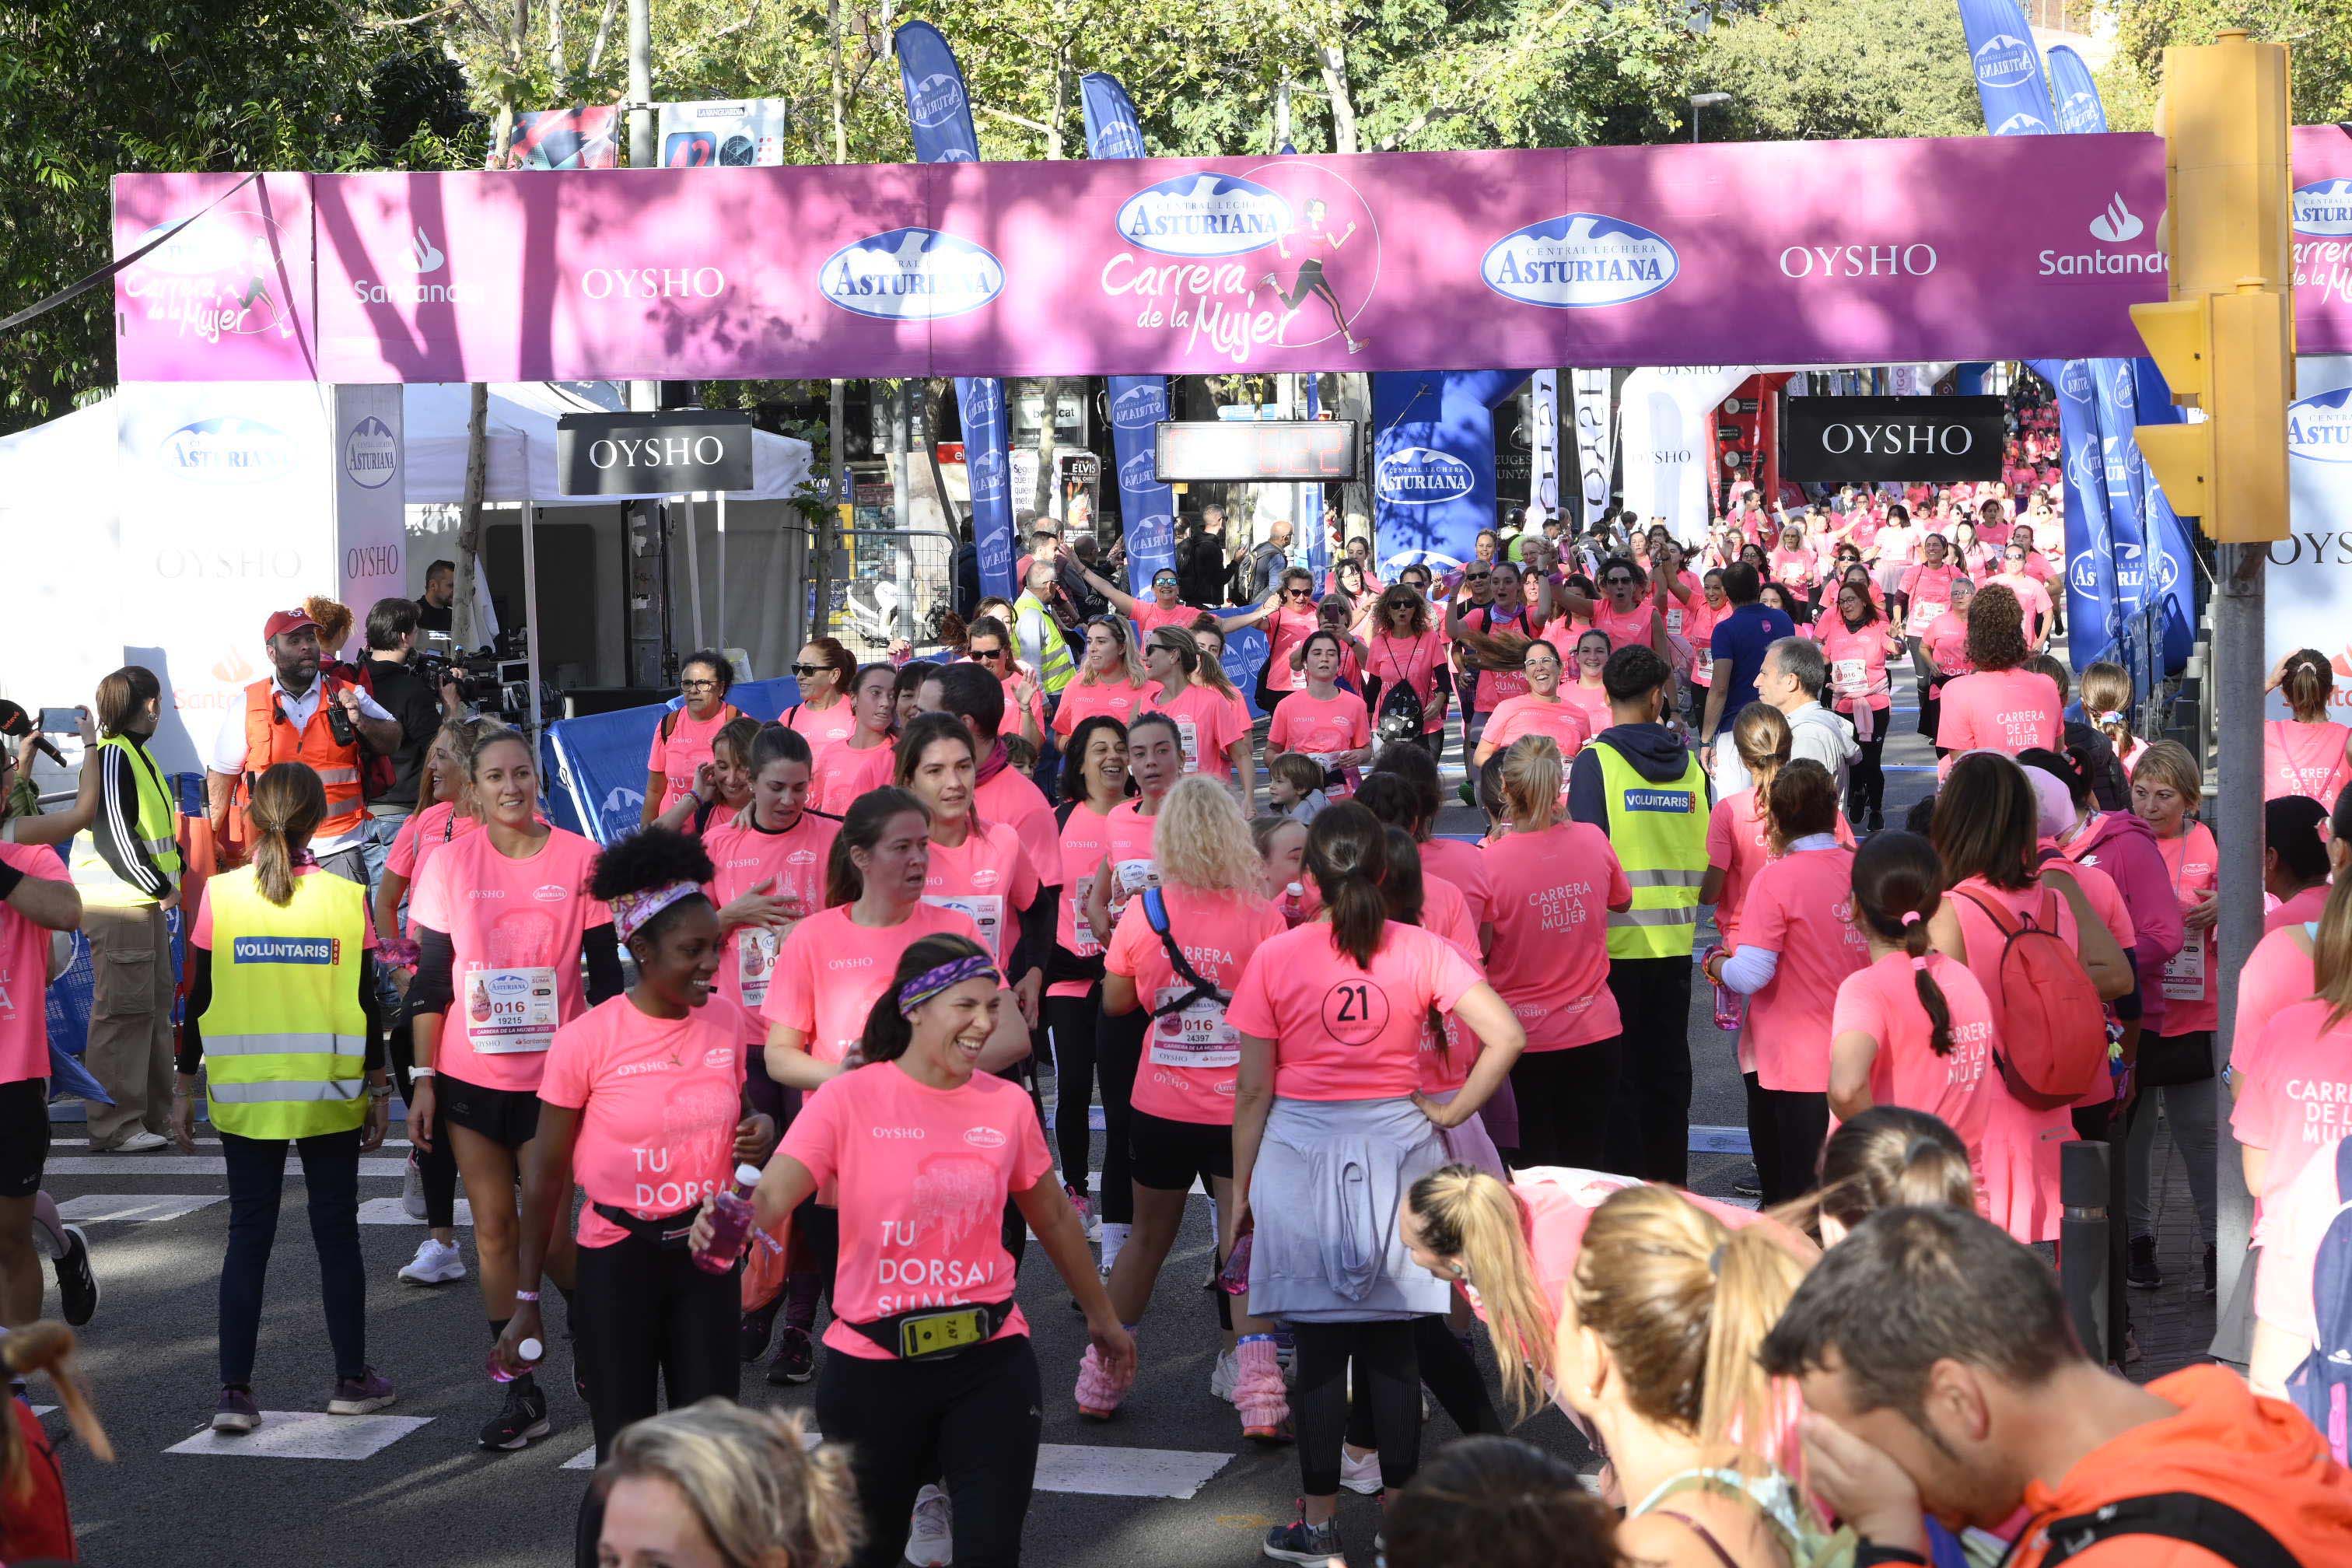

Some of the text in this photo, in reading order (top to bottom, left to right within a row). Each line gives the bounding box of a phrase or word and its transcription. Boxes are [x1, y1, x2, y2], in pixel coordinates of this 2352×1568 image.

[1130, 205, 1279, 236] ASTURIANA
[1527, 244, 1657, 256] CENTRAL LECHERA
[1780, 243, 1937, 278] OYSHO
[1101, 253, 1248, 296] Carrera
[1496, 249, 1664, 285] ASTURIANA
[582, 267, 725, 299] OYSHO
[1137, 289, 1301, 363] de la Mujer
[1822, 423, 1972, 455] OYSHO
[348, 444, 394, 471] ASTURIANA
[590, 436, 724, 468] OYSHO
[1072, 463, 1096, 474] ELVIS
[1380, 469, 1468, 492] ASTURIANA
[156, 548, 303, 579] OYSHO
[347, 544, 398, 579] OYSHO
[1495, 682, 1521, 691] SUMA
[1997, 710, 2046, 725] CARRERA
[2006, 723, 2036, 735] DE LA
[2006, 734, 2039, 747] MUJER
[1626, 794, 1688, 807] VOLUNTARIS
[1066, 840, 1097, 849] OYSHO
[726, 857, 759, 869] OYSHO
[469, 890, 505, 900] OYSHO
[1528, 880, 1592, 907] CARRERA
[1542, 897, 1583, 918] DE LA
[1541, 909, 1587, 931] MUJER
[236, 943, 329, 958] VOLUNTARIS
[1161, 947, 1234, 965] CRRERA
[829, 957, 873, 970] OYSHO
[494, 1001, 526, 1013] 016
[1336, 985, 1368, 1022] 21
[1184, 1019, 1213, 1031] 016
[618, 1060, 669, 1077] OYSHO
[2305, 1102, 2336, 1125] DE
[873, 1126, 926, 1139] OYSHO
[632, 1147, 668, 1173] TU
[881, 1220, 915, 1247] TU
